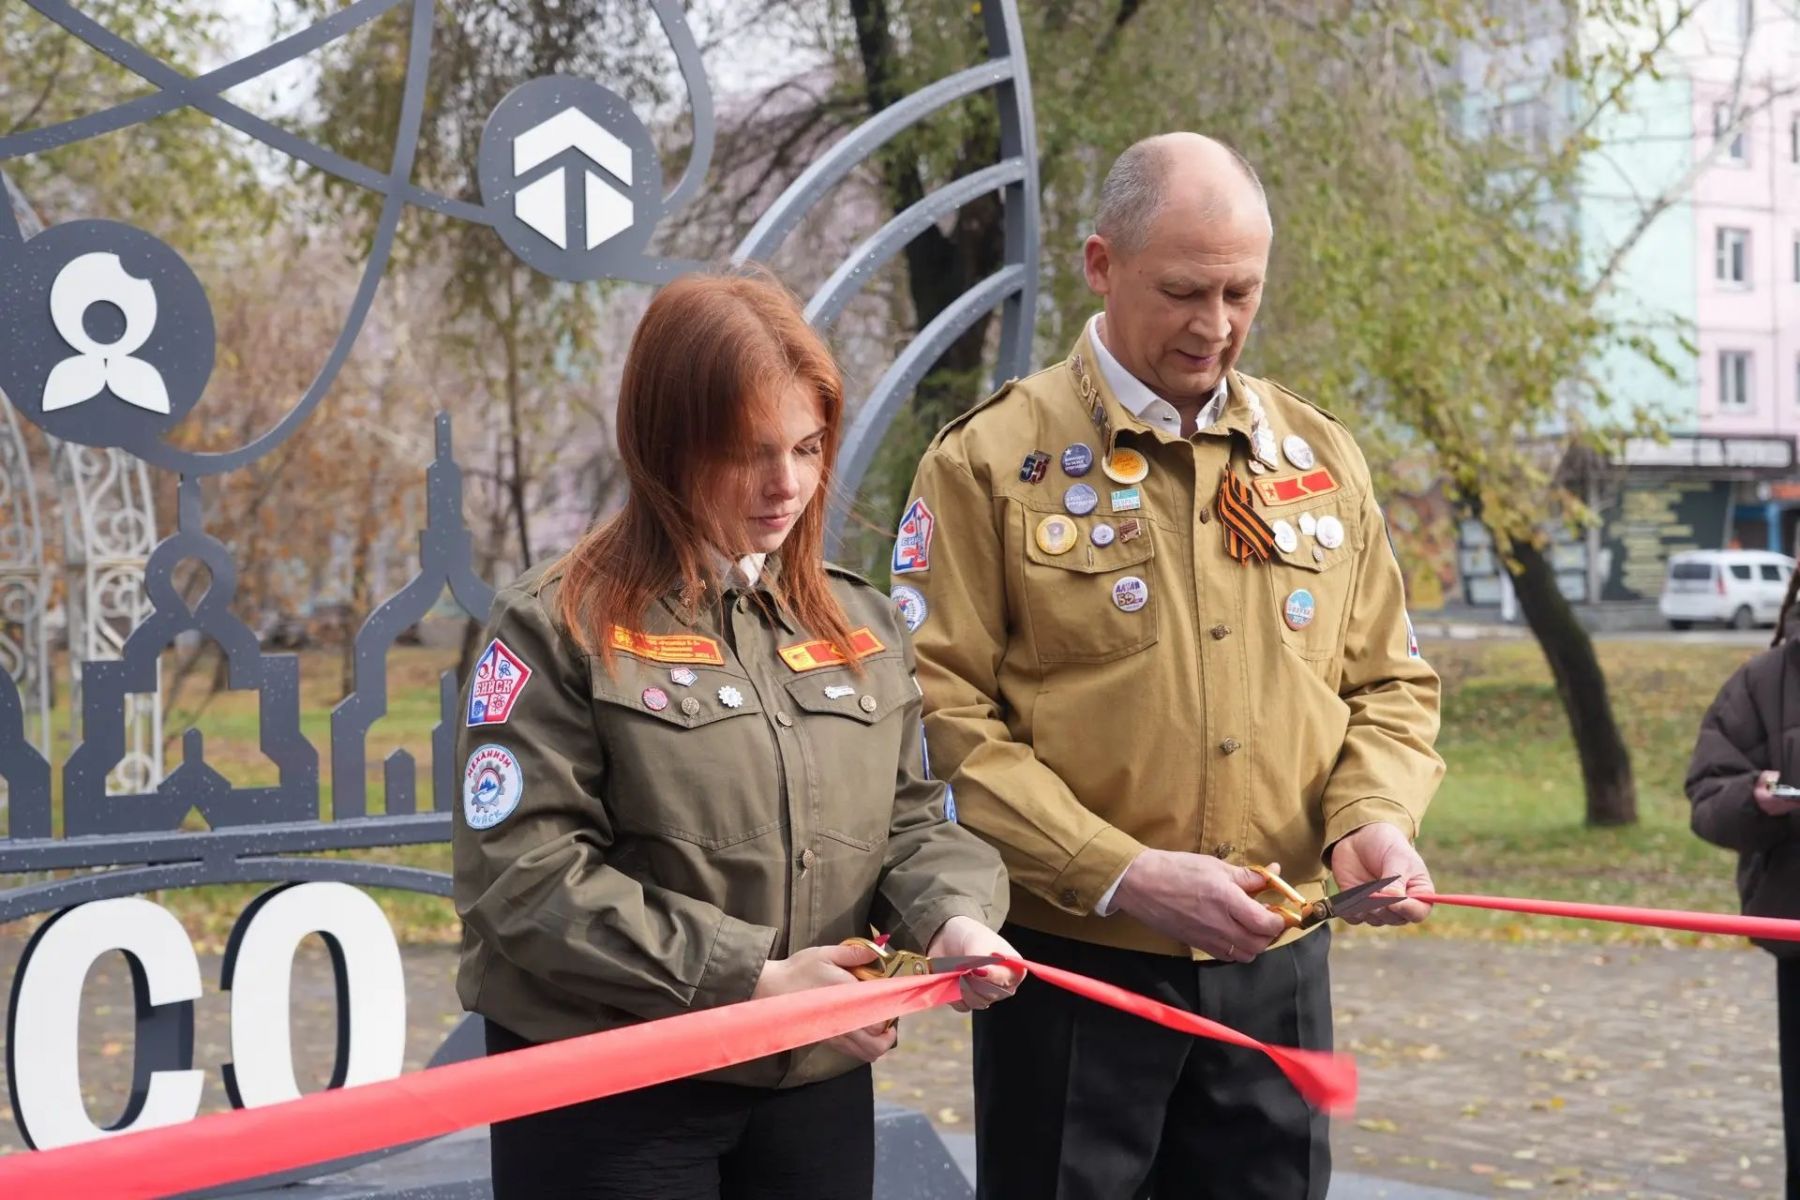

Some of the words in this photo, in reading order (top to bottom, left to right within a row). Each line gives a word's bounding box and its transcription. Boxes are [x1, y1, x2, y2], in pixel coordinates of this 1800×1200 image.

[474, 679, 513, 697] БИЙСК
[467, 750, 512, 778] МЕХАНИЗМ
[8, 881, 406, 1151] СО
